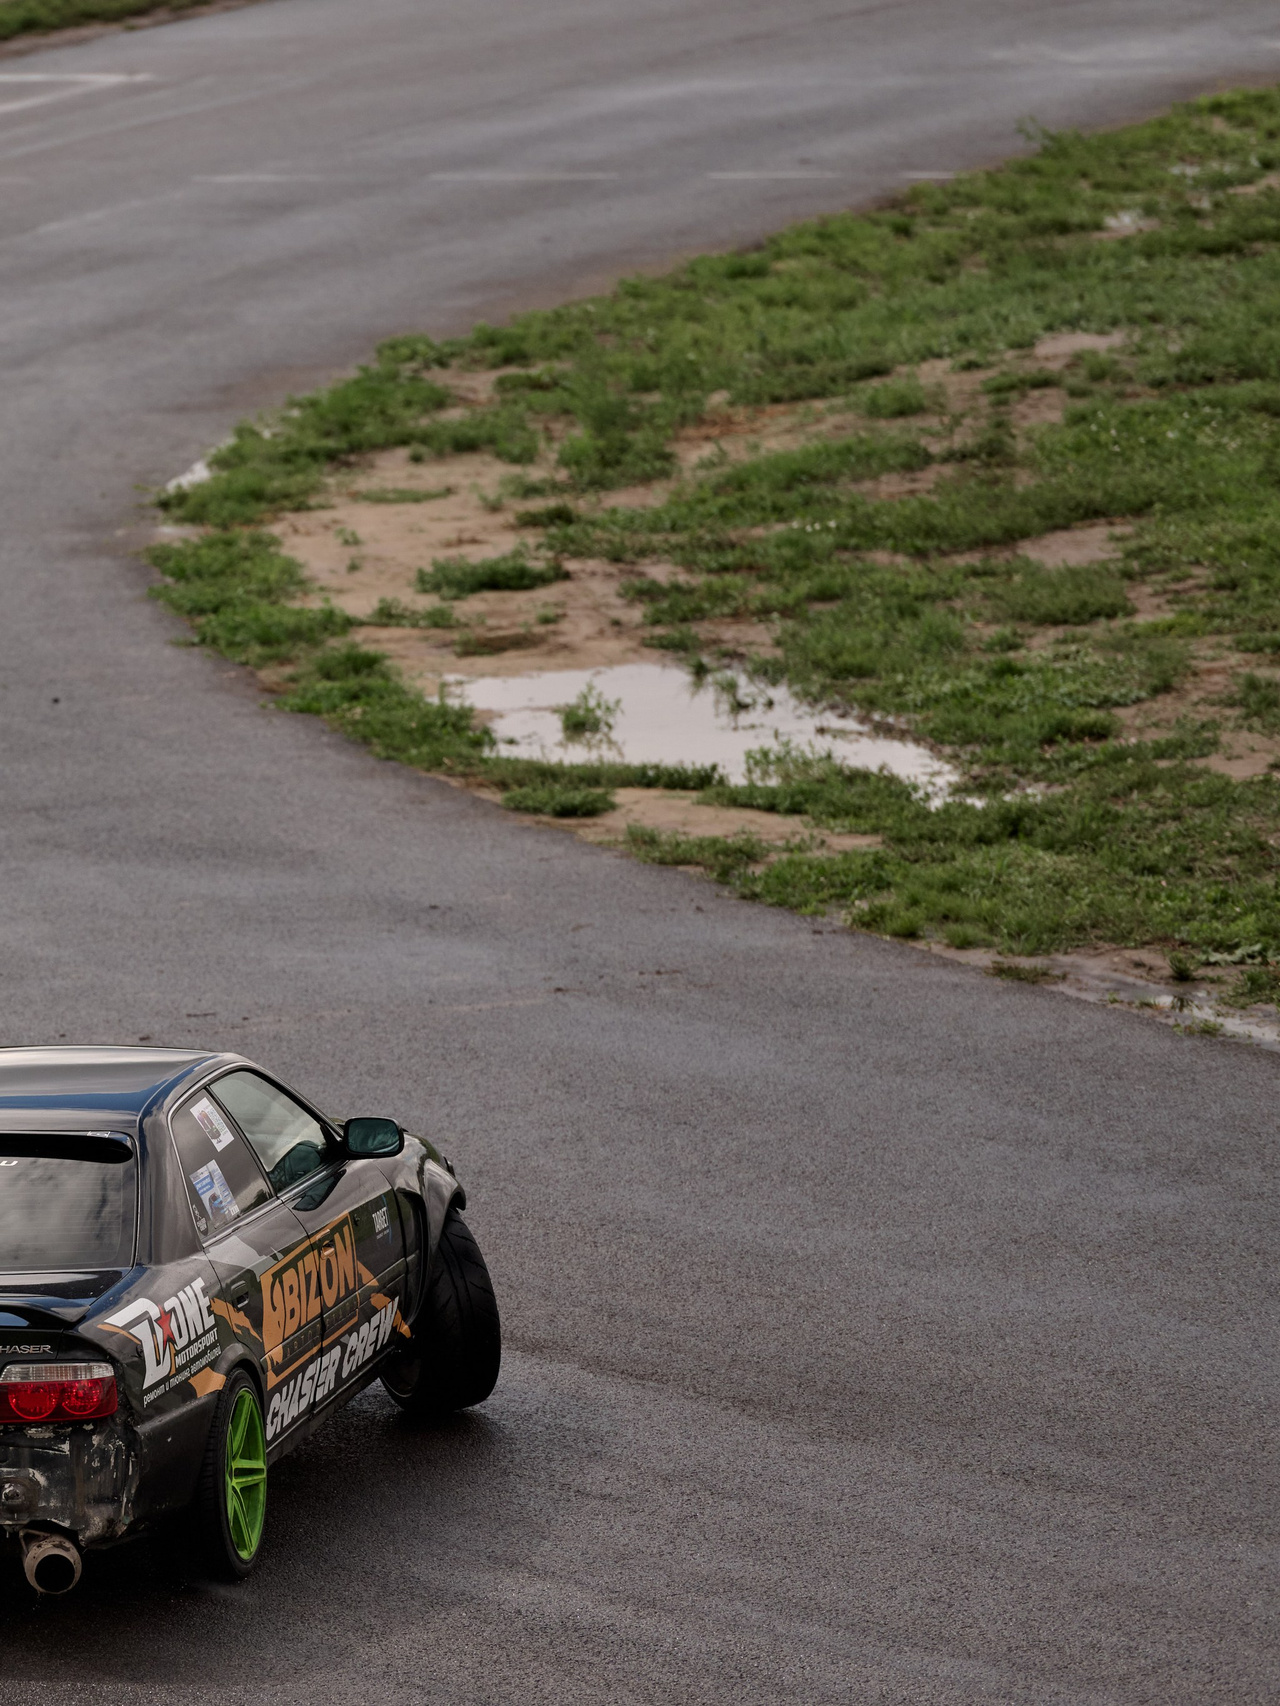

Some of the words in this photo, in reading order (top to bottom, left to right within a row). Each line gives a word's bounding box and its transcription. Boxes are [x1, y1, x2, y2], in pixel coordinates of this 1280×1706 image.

[282, 1224, 355, 1339] BIZON
[174, 1327, 218, 1369] MOTORSPORT
[266, 1344, 343, 1441] CHASER
[342, 1296, 400, 1379] CREW
